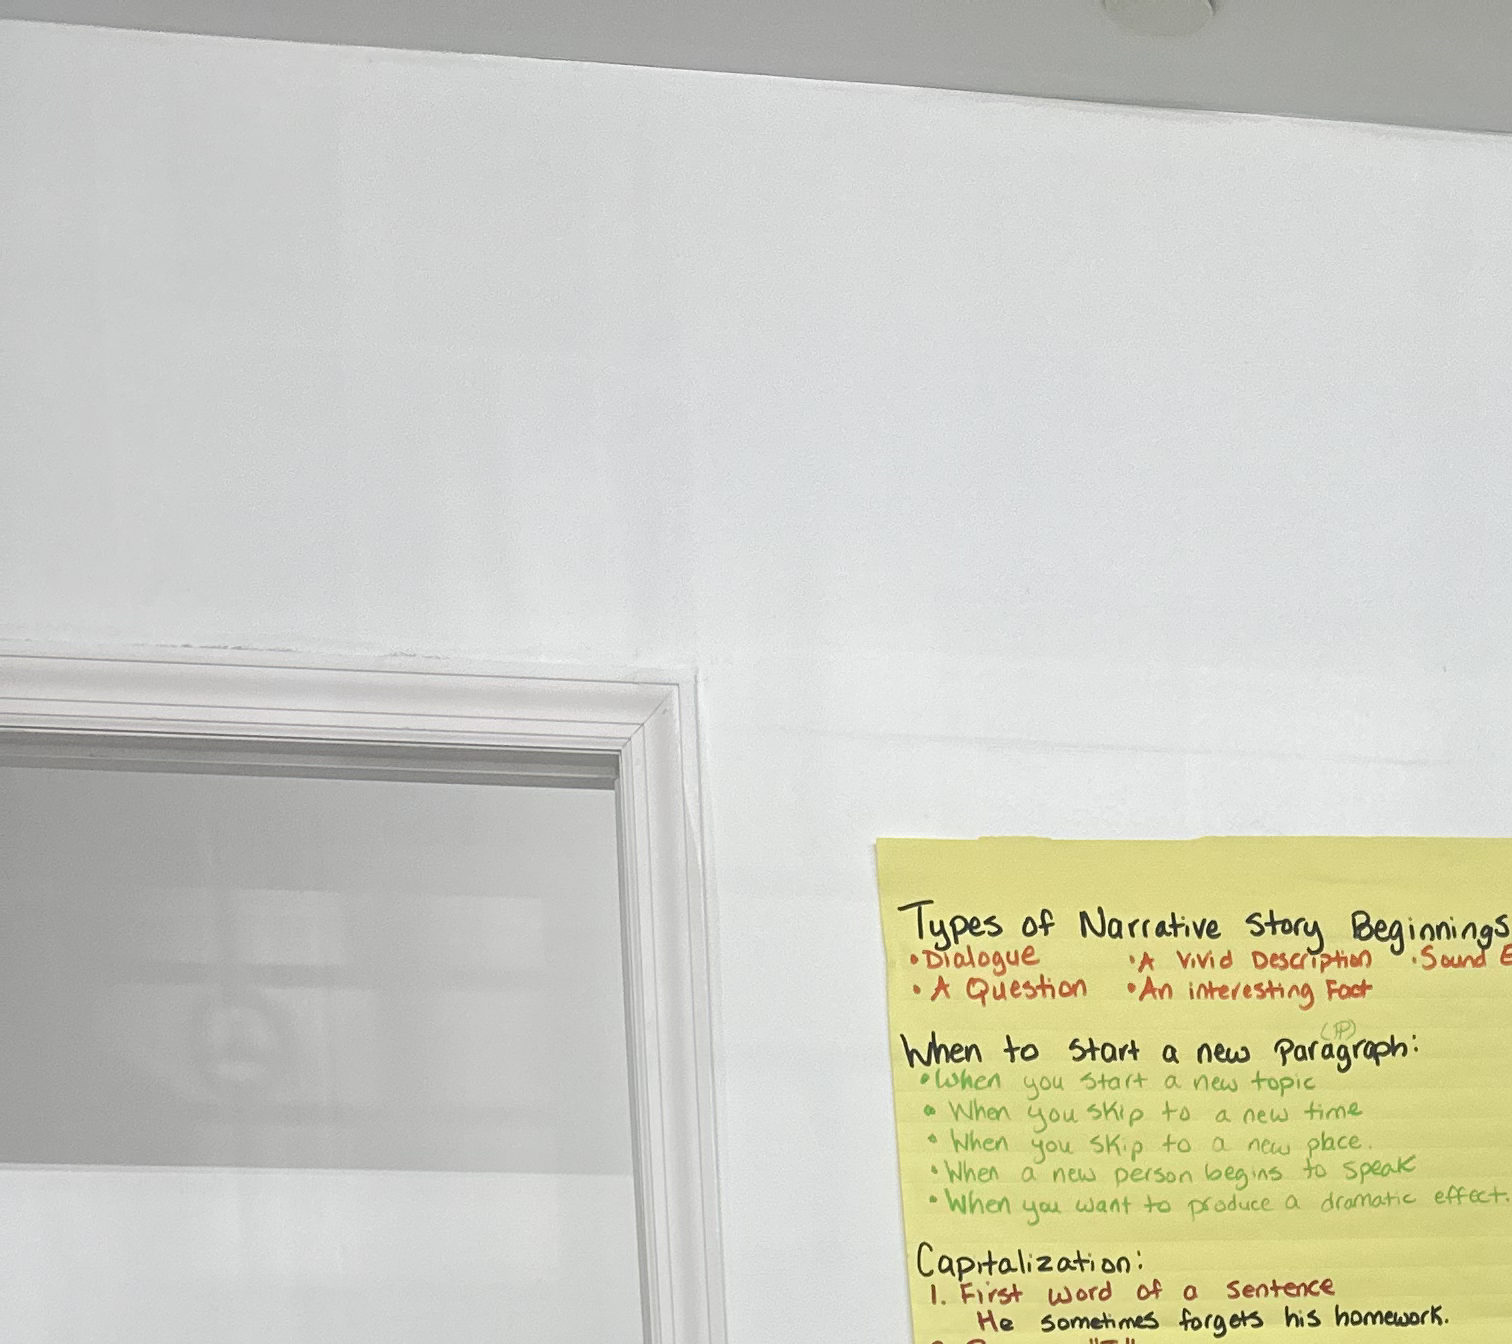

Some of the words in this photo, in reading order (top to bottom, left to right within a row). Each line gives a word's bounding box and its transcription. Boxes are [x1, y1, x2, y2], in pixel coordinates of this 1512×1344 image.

[897, 900, 1004, 952] Types
[1021, 908, 1055, 939] of
[1078, 907, 1221, 941] Narrative
[922, 942, 1040, 977] Dialogue
[1137, 951, 1155, 973] A
[1251, 946, 1372, 974] Description
[1420, 943, 1491, 971] Sound
[930, 975, 950, 1002] A
[966, 974, 1087, 1006] Question
[1138, 975, 1173, 1002] An
[1325, 979, 1373, 1001] Fact
[900, 1030, 983, 1069] When
[1003, 1034, 1039, 1063] to
[1161, 1044, 1179, 1064] a
[1196, 1042, 1251, 1064] new
[935, 1068, 1001, 1091] When
[1024, 1076, 1064, 1101] you
[1164, 1074, 1181, 1089] a
[1194, 1074, 1238, 1092] new
[1251, 1070, 1315, 1097] topic
[944, 1160, 999, 1183] When
[1022, 1166, 1036, 1182] a
[1053, 1168, 1096, 1182] new
[1115, 1167, 1192, 1188] person
[1205, 1163, 1282, 1191] begins
[1303, 1158, 1327, 1179] to
[916, 1241, 1142, 1281] Capitalization:
[931, 1284, 946, 1305] 1.
[958, 1277, 1023, 1305] First
[1136, 1278, 1163, 1301] of
[1183, 1284, 1198, 1301] a
[977, 1309, 1014, 1332] He
[1041, 1311, 1160, 1334] sometimes
[1178, 1307, 1264, 1340] forgets
[1285, 1305, 1321, 1328] his
[1335, 1304, 1449, 1328] homework.
